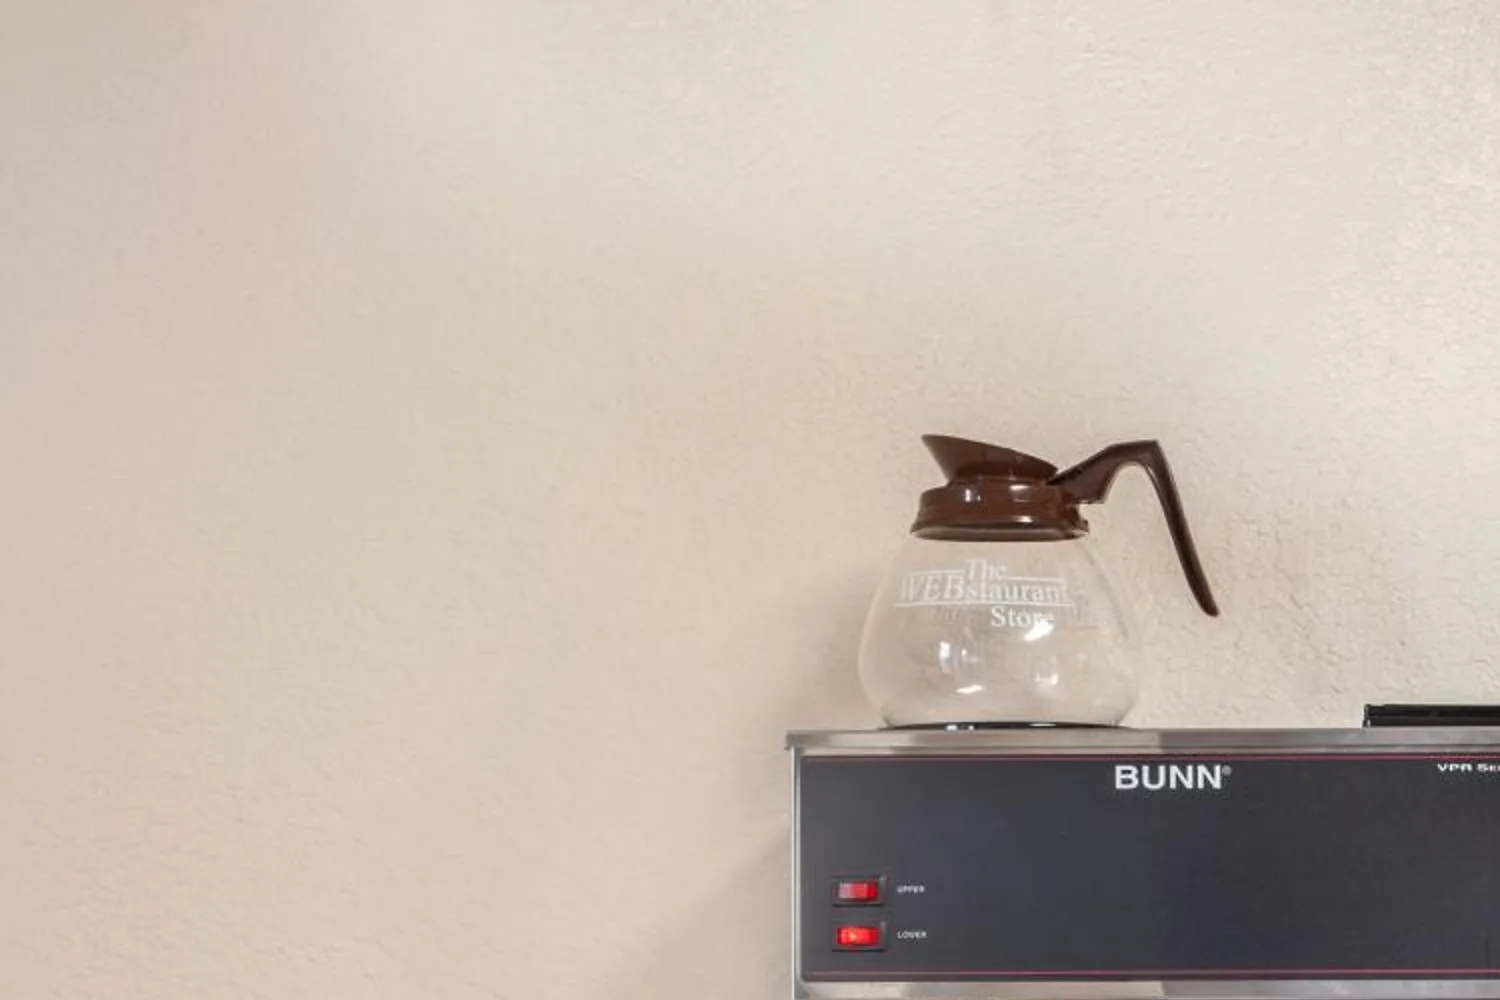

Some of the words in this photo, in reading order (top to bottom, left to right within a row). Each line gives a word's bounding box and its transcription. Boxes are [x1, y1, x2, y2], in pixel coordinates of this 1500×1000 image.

[964, 558, 1008, 581] The
[991, 606, 1055, 628] Store
[1115, 764, 1222, 790] BUNN
[1437, 763, 1473, 773] VPR
